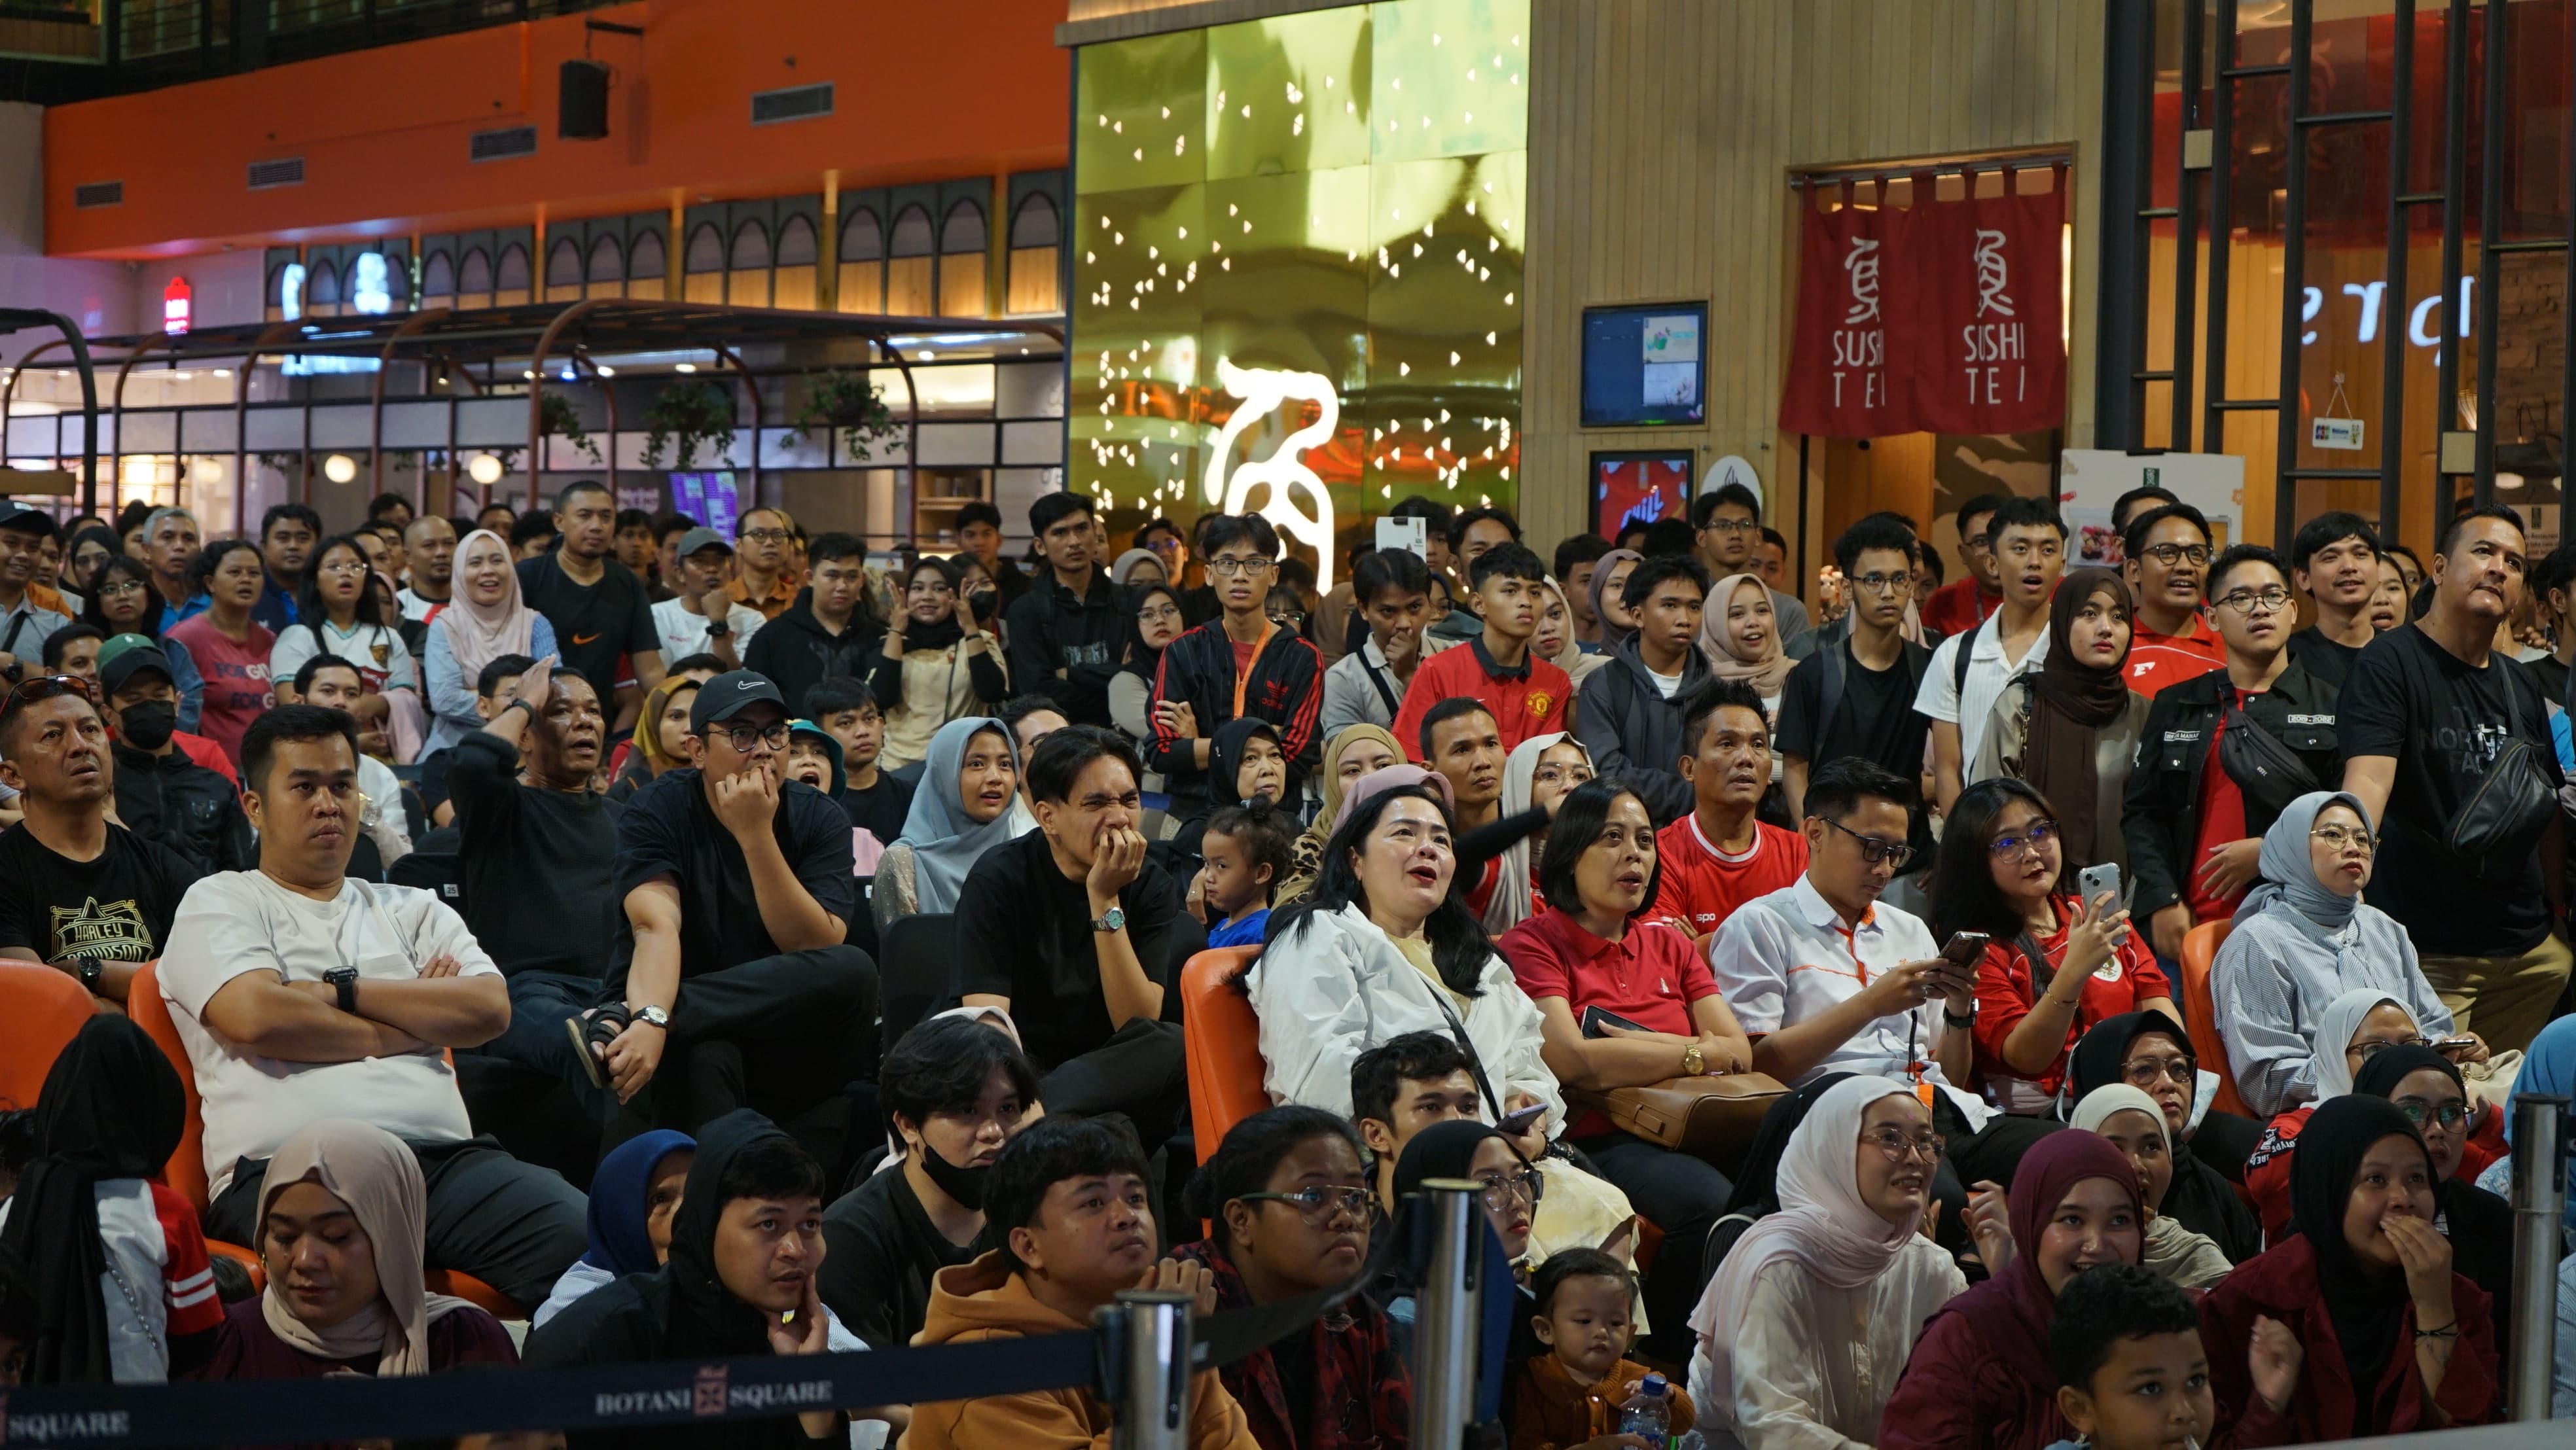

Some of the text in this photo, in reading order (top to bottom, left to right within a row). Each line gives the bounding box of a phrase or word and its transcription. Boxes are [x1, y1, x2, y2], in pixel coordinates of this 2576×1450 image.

[1963, 322, 2025, 362] SUSHI
[75, 923, 123, 942] HARLEY
[1696, 913, 1716, 923] spo
[595, 1379, 833, 1415] BOTANI SQUARE
[9, 1410, 129, 1443] SQUARE
